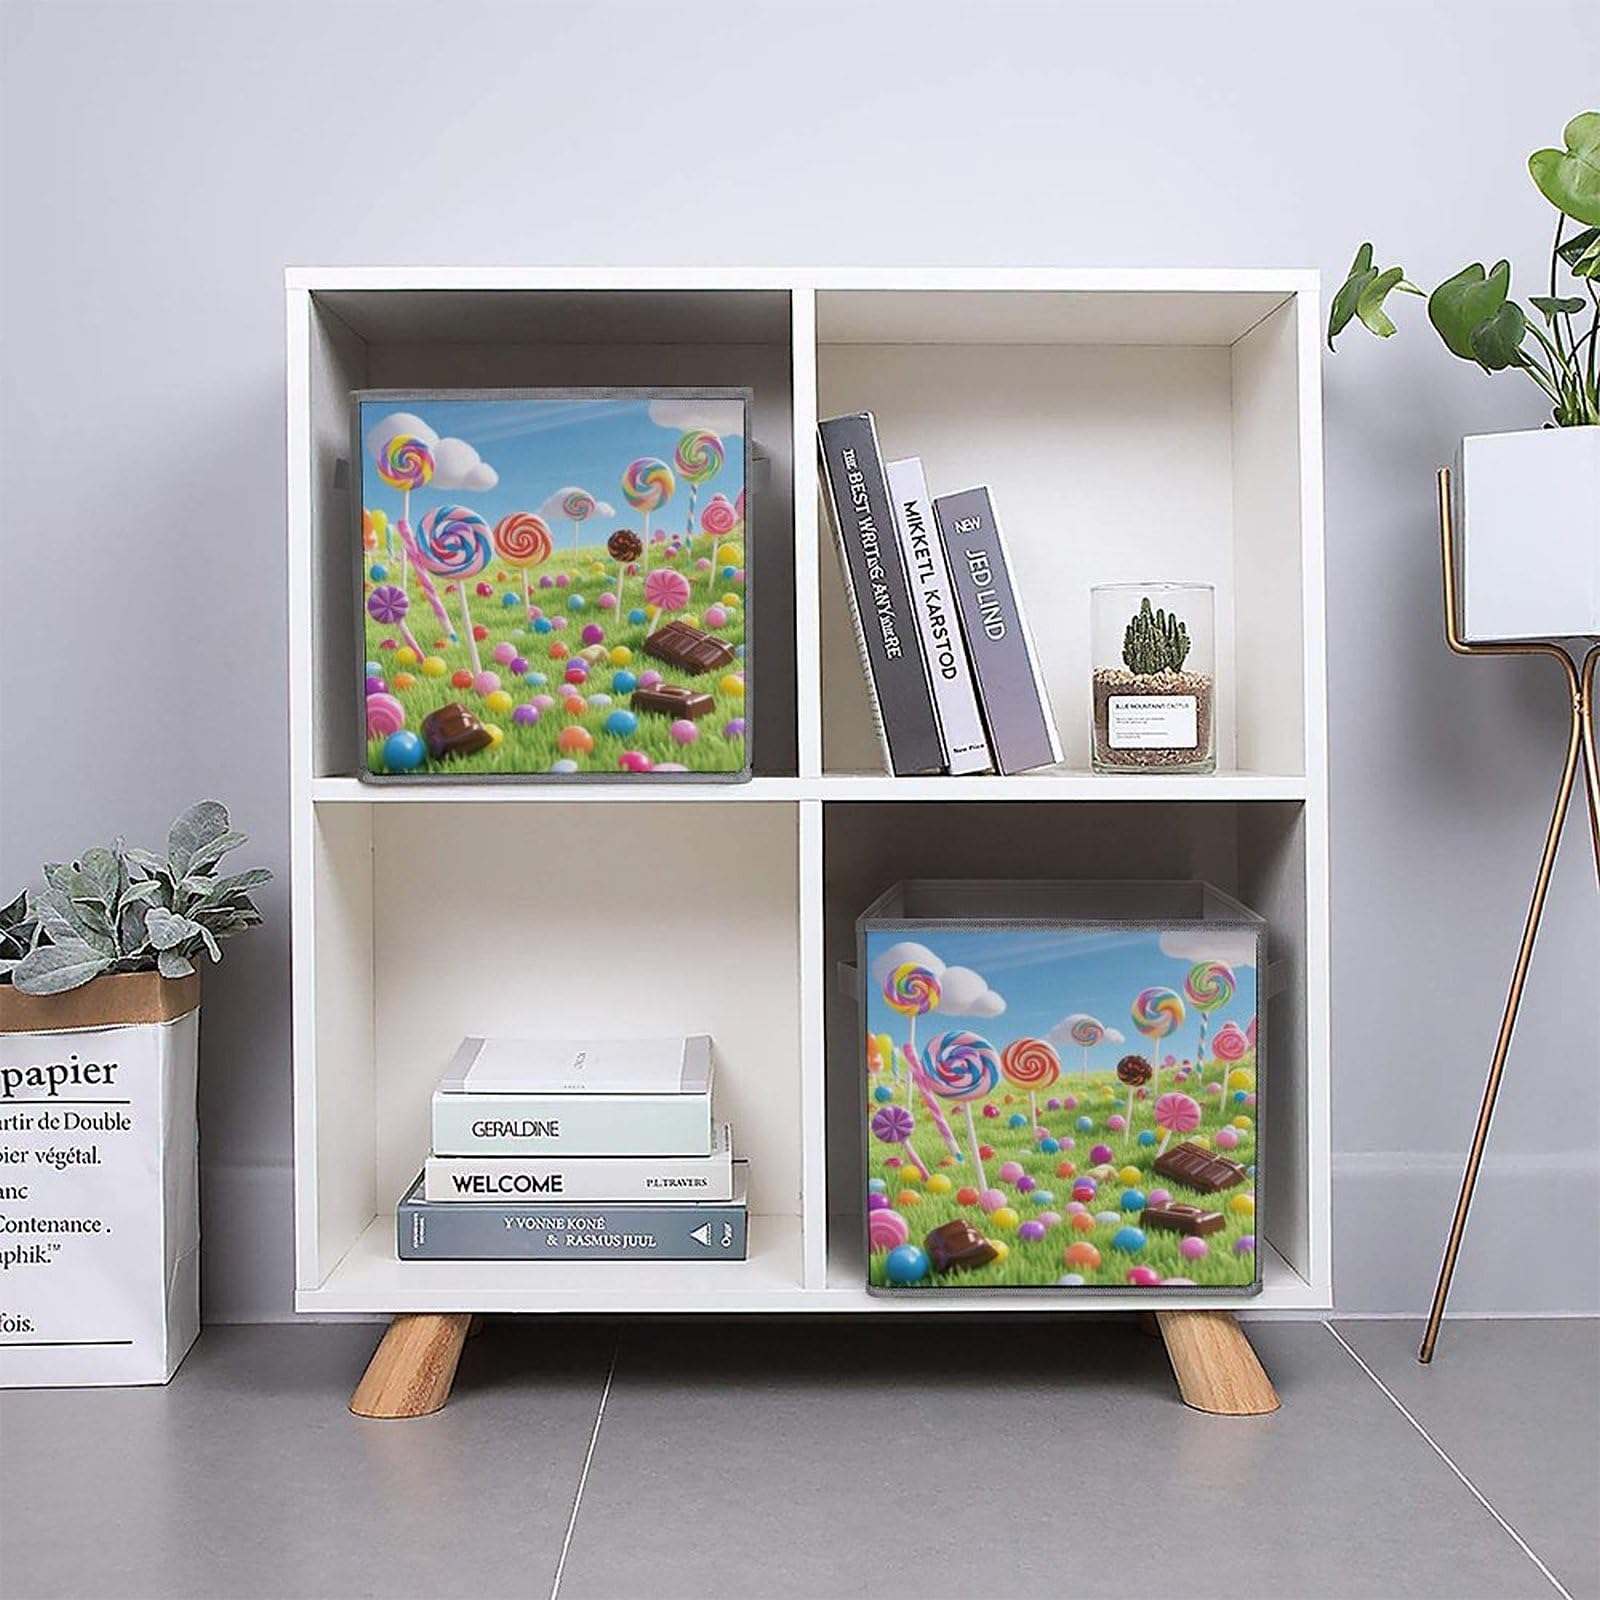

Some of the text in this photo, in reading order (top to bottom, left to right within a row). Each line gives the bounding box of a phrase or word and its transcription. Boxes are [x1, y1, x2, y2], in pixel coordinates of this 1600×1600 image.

[849, 471, 872, 516] BEST
[954, 516, 982, 535] NEW
[903, 500, 957, 680] MIKKETL KARSTOD
[966, 549, 1007, 641] JED LIND
[0, 1055, 119, 1098] papier
[0, 1111, 132, 1131] rtir de Double
[471, 1120, 560, 1138] GERALDINE
[34, 1145, 102, 1170] végétal.
[452, 1174, 564, 1194] WELCOME
[566, 1215, 607, 1231] KONÉ
[545, 1234, 657, 1248] & RASMUS JUUL
